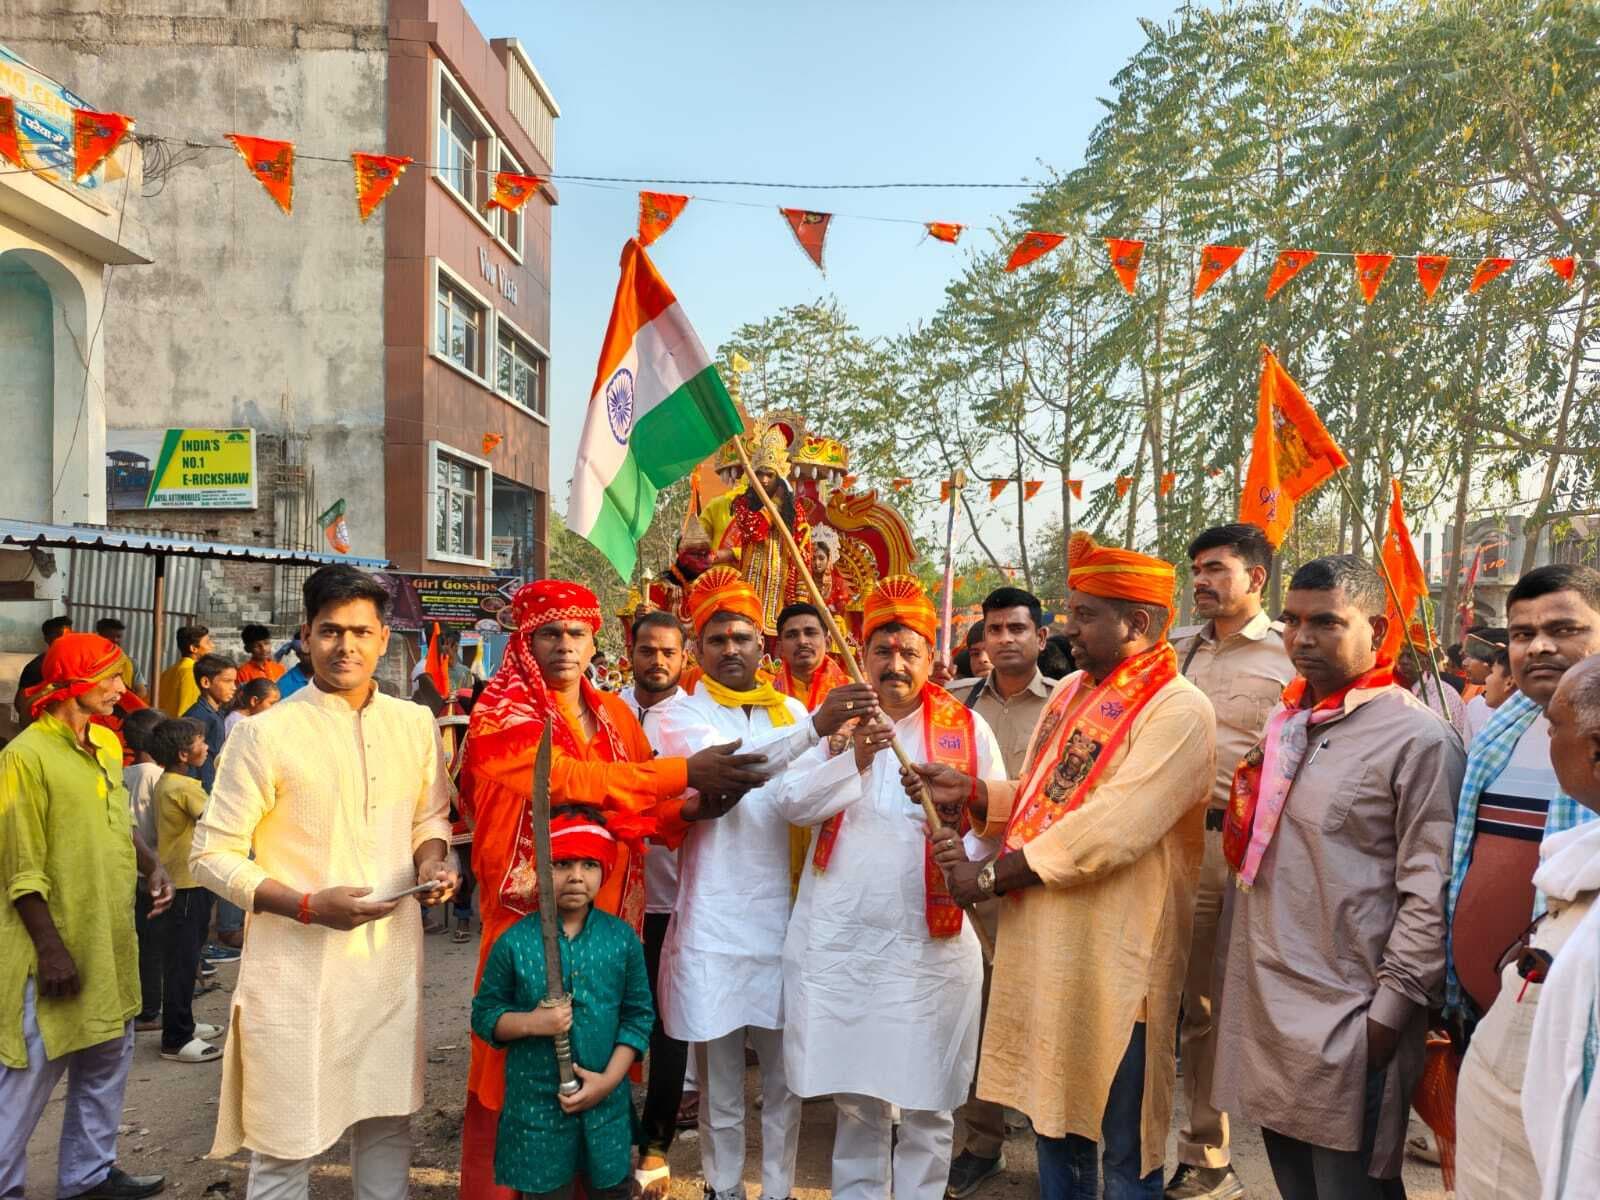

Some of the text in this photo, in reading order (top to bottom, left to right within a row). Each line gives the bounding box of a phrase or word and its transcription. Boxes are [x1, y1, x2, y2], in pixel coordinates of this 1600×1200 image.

[182, 439, 220, 452] INDIA'S
[182, 456, 205, 469] NO.1
[183, 473, 249, 486] E-RICKSHAW
[412, 579, 439, 589] Girl
[442, 580, 497, 592] Gossips
